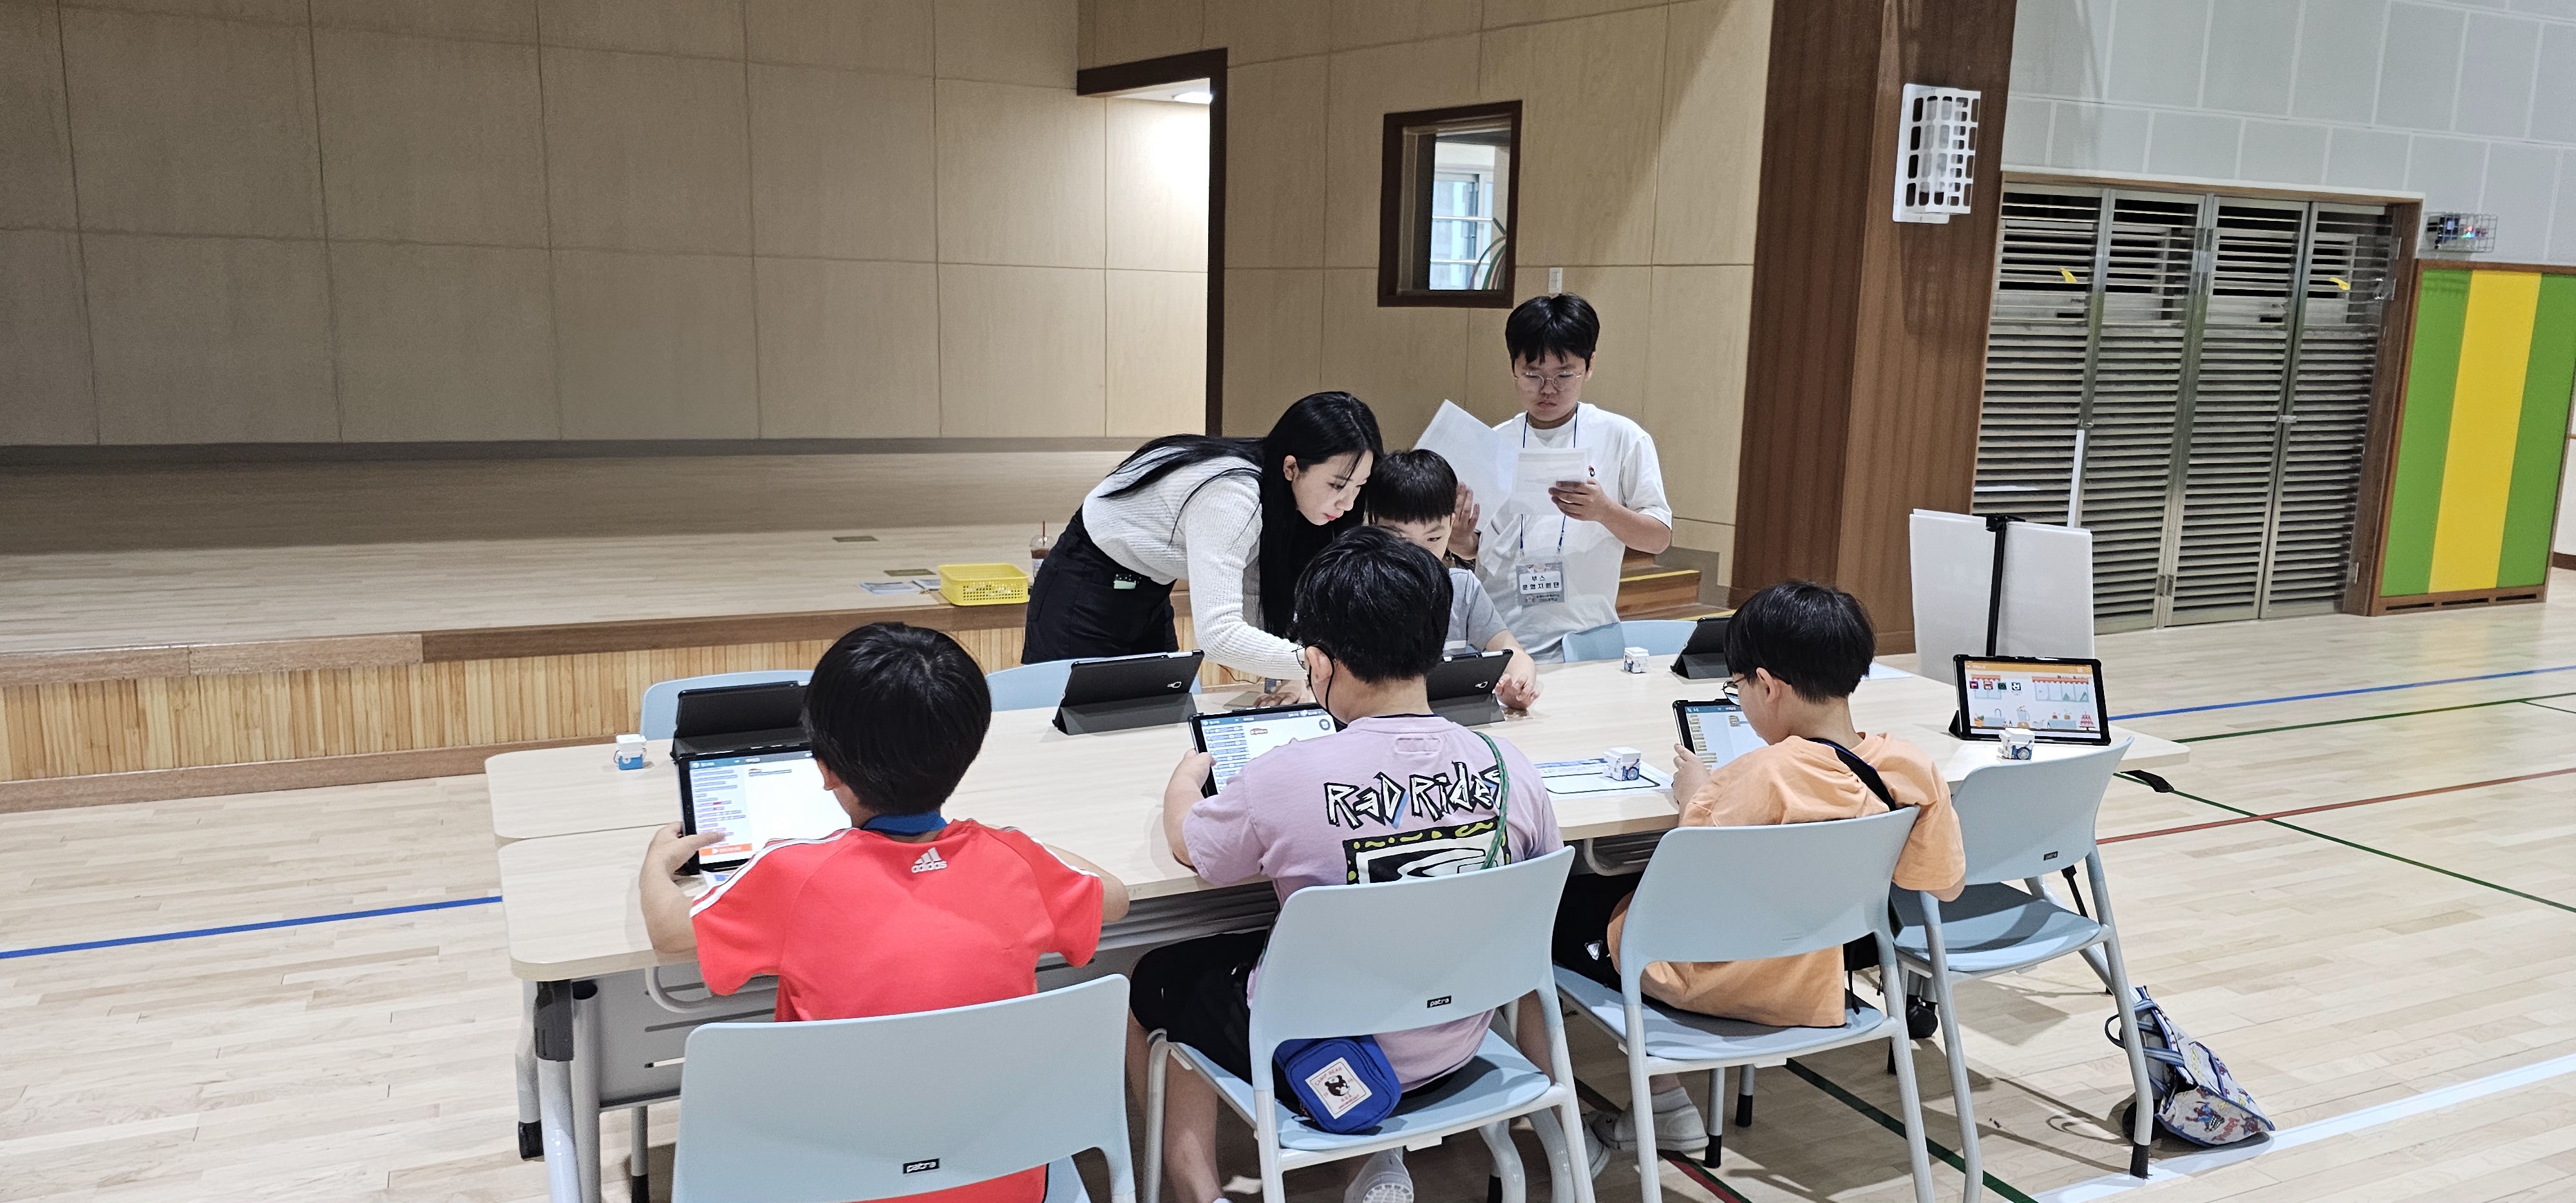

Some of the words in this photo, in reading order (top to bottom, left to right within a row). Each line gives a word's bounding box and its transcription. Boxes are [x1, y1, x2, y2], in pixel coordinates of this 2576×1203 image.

[911, 860, 947, 873] adidas
[1430, 998, 1449, 1007] patra
[906, 1162, 936, 1173] patra
